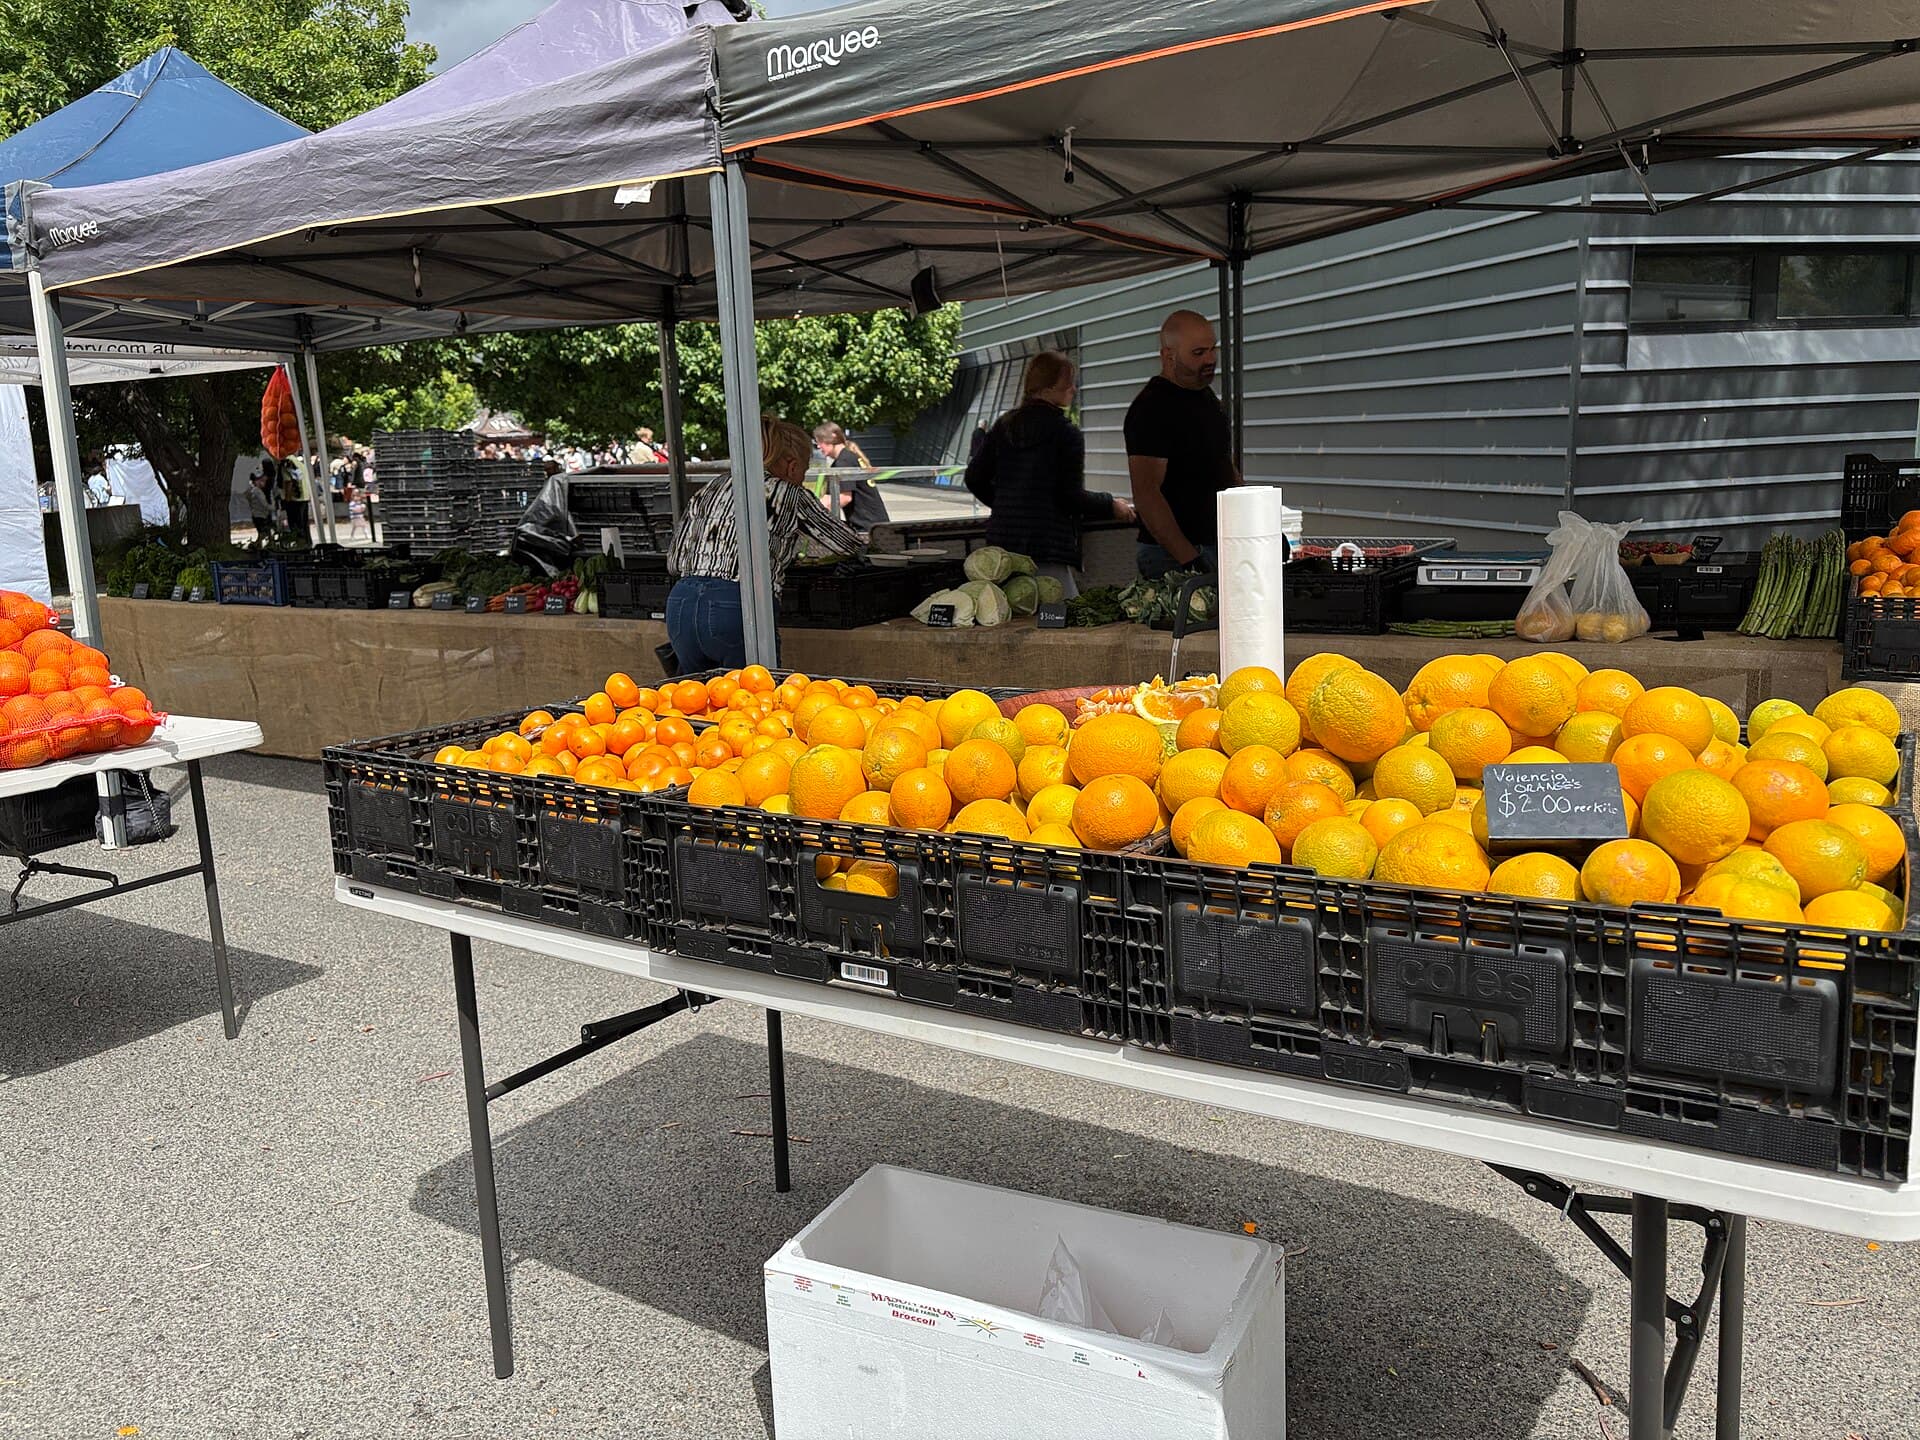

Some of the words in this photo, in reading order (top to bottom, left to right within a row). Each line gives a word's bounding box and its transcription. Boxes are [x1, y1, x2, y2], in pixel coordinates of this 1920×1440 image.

[1493, 768, 1567, 783] Valencia
[1498, 789, 1571, 818] $2.00
[1398, 959, 1534, 1000] coles
[887, 1301, 919, 1314] VEGETABLE
[892, 1309, 936, 1327] Broccoli
